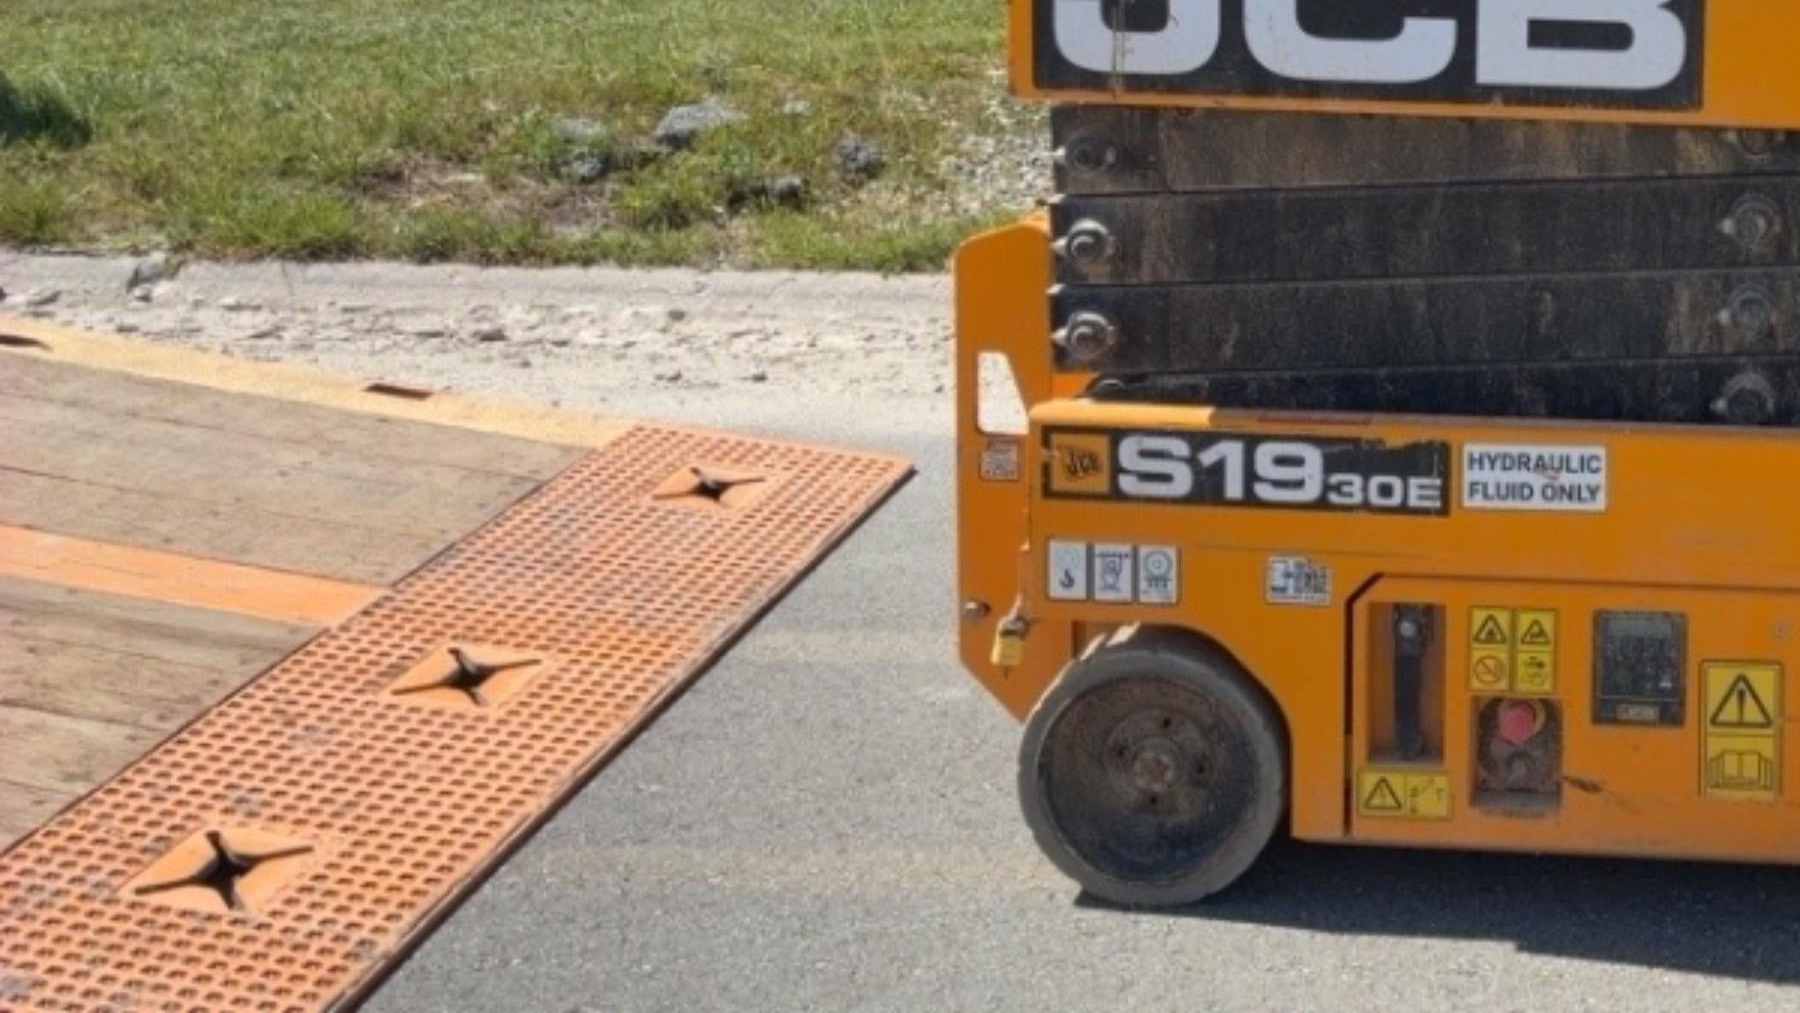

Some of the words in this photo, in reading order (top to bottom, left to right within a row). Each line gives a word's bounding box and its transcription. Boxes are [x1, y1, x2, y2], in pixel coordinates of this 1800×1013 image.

[1467, 451, 1603, 475] HYDRAULIC
[1467, 481, 1534, 502] FLUID
[1541, 483, 1601, 504] ONLY
